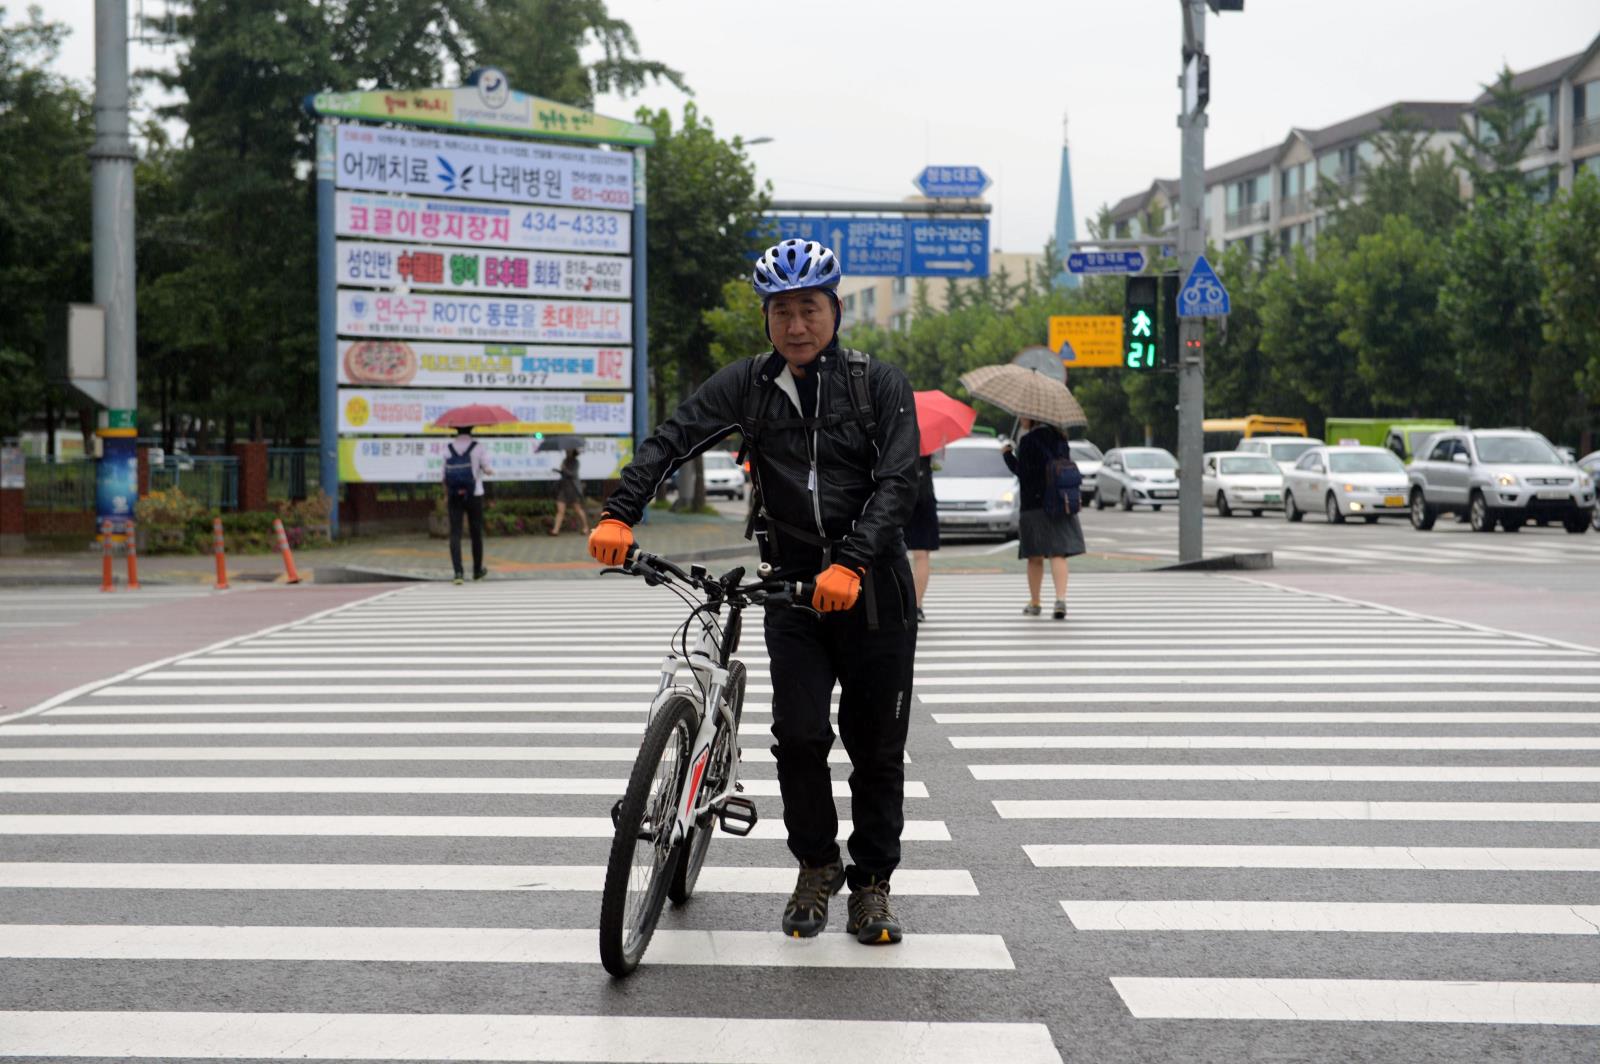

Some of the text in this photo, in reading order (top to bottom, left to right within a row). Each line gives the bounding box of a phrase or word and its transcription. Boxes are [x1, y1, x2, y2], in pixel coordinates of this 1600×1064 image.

[343, 151, 562, 199] 어깨치료 나래병원
[349, 205, 511, 242] 코골이방지장치
[521, 211, 618, 235] 434-4333
[347, 250, 392, 279] 성인반
[450, 254, 478, 286] 영어
[534, 260, 561, 289] 회화
[375, 297, 428, 323] 연수구
[433, 303, 481, 324] ROTC
[487, 304, 535, 328] 동문을
[541, 304, 620, 330] 초대합니다
[1127, 342, 1155, 368] 21
[464, 373, 549, 385] 816-9977
